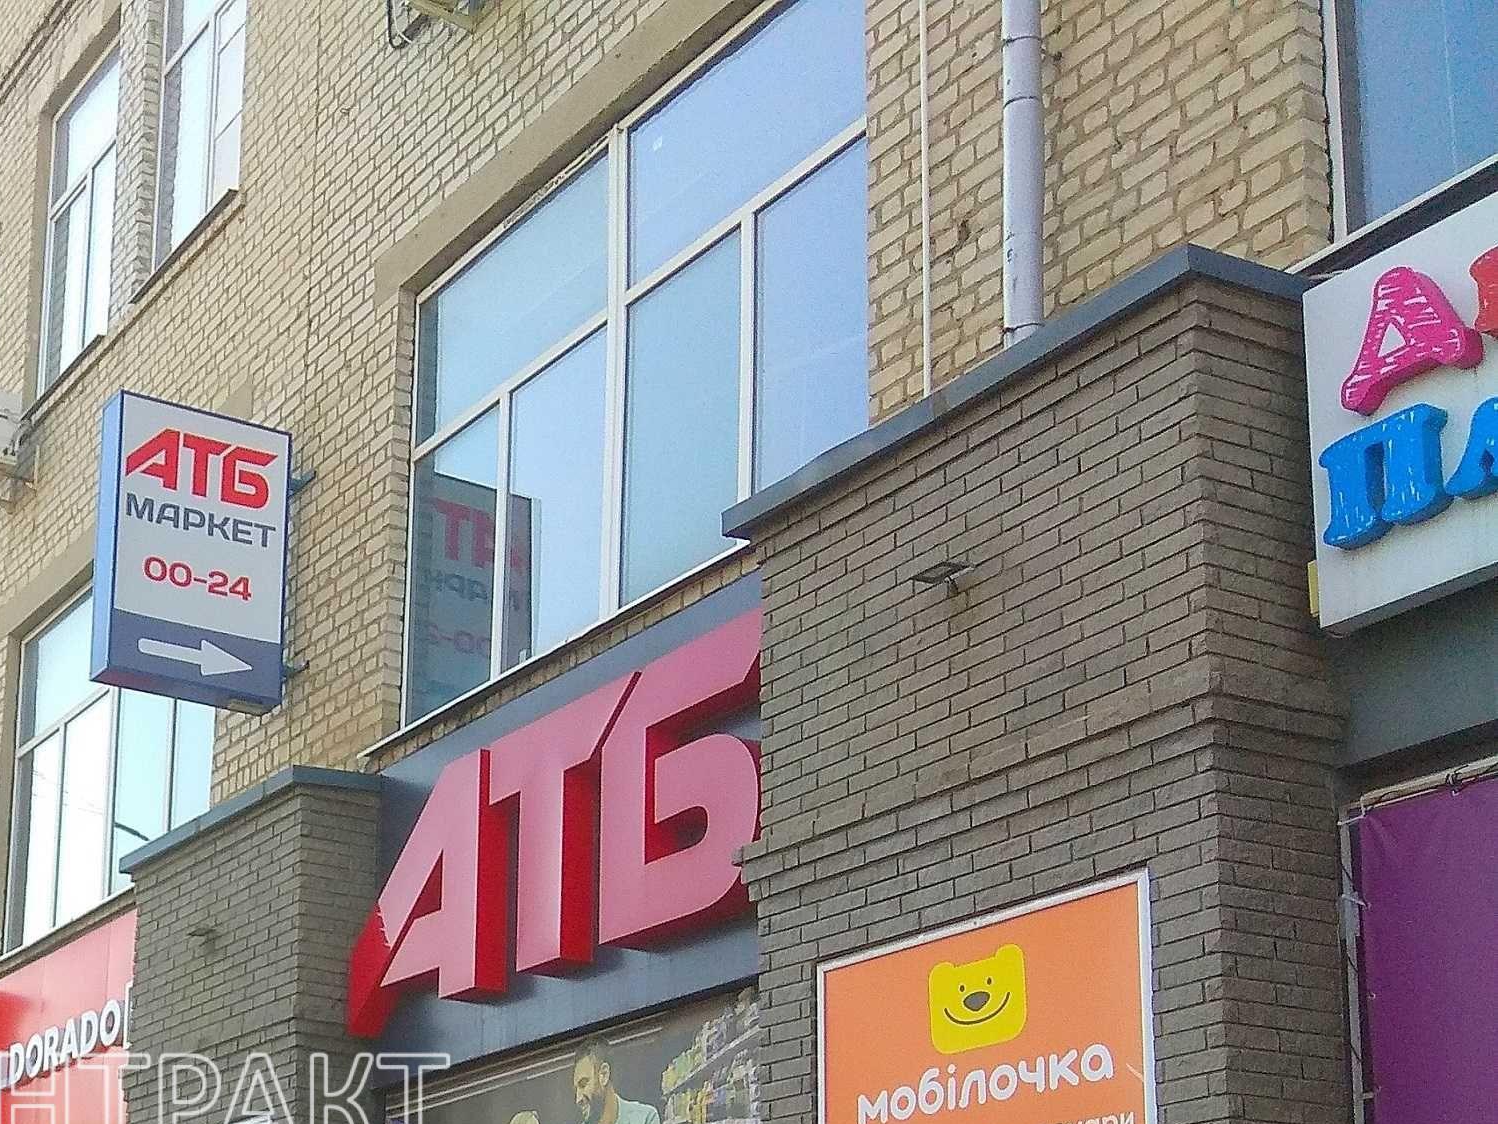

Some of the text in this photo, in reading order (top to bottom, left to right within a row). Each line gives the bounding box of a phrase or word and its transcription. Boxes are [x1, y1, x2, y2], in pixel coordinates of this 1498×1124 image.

[125, 427, 278, 509] АТБ
[126, 493, 277, 548] МАРКЕТ
[143, 555, 253, 602] 00-24
[352, 608, 763, 1020] АТБ
